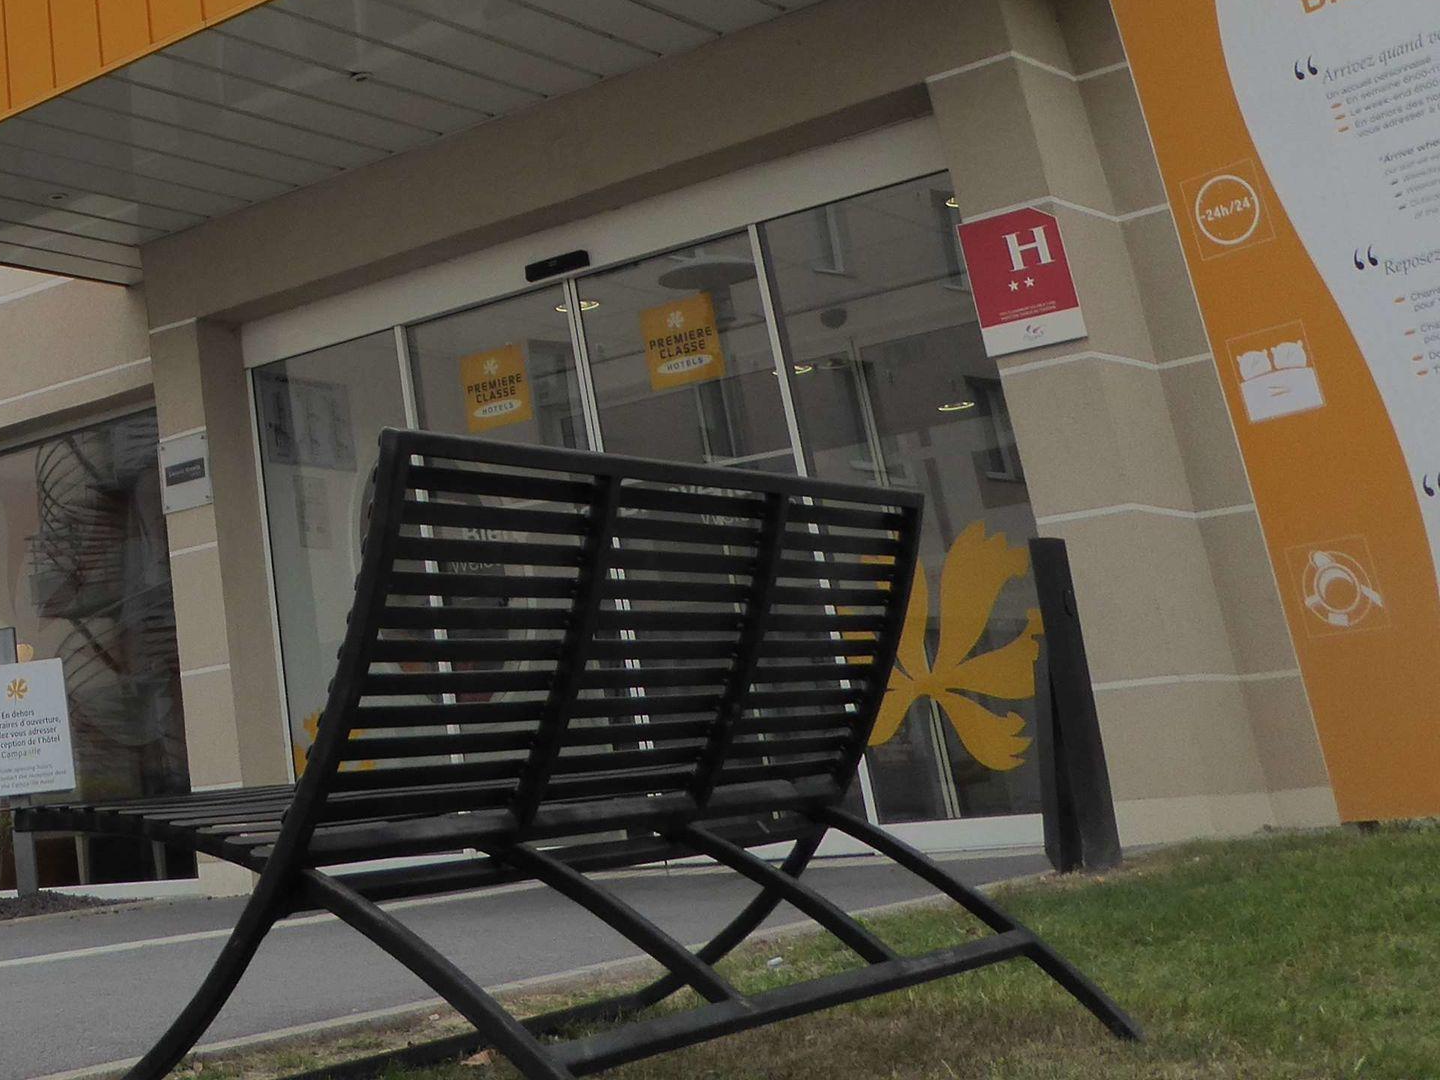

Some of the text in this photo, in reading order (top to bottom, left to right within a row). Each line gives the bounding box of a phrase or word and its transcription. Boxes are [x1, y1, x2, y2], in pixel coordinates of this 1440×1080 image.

[1002, 224, 1056, 272] H
[649, 326, 712, 350] PREMIERE
[660, 340, 706, 359] CLASSE
[666, 357, 703, 371] HOTELS
[467, 373, 522, 395] PREMIERE
[476, 386, 516, 403] CLASSE
[482, 402, 514, 415] HOTELS
[11, 709, 35, 718] dehors
